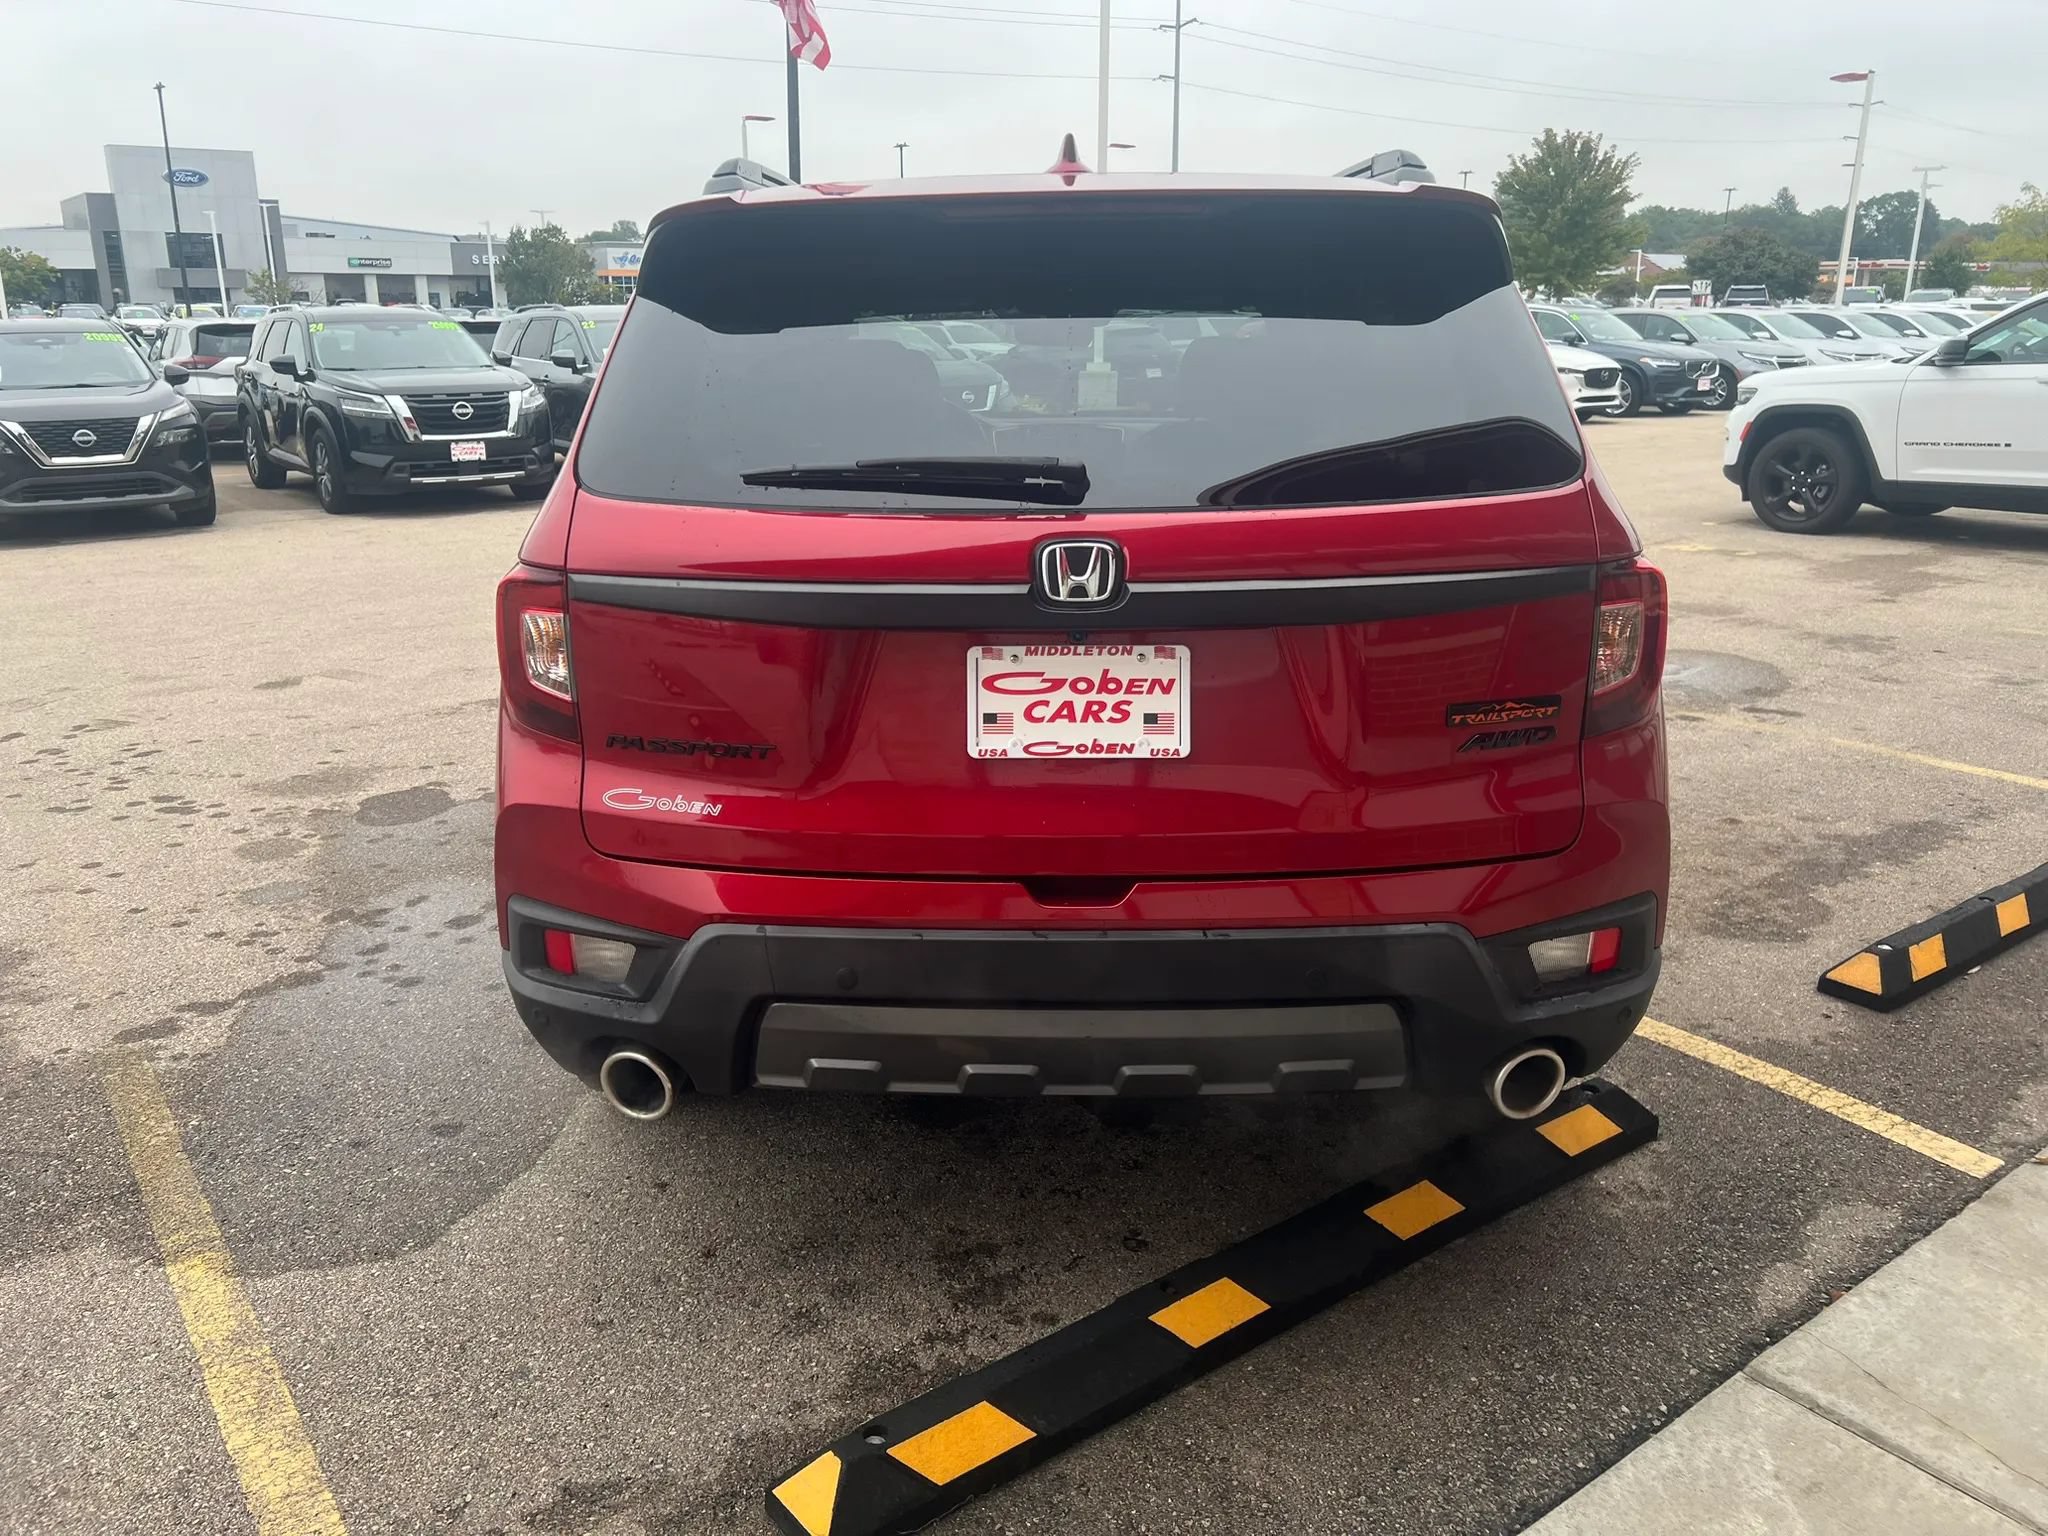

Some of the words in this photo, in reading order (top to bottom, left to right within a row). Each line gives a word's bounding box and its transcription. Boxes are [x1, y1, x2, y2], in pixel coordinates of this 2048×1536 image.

[173, 171, 199, 182] Ford
[309, 322, 324, 332] 24
[581, 321, 596, 329] 22
[1024, 645, 1134, 657] MIDDLETON
[1023, 700, 1134, 724] CARS
[1451, 706, 1558, 724] TRAILSPORT
[1456, 726, 1557, 752] AWD
[606, 735, 777, 760] PASSPORT
[977, 748, 1008, 758] USA
[1150, 748, 1181, 757] USA
